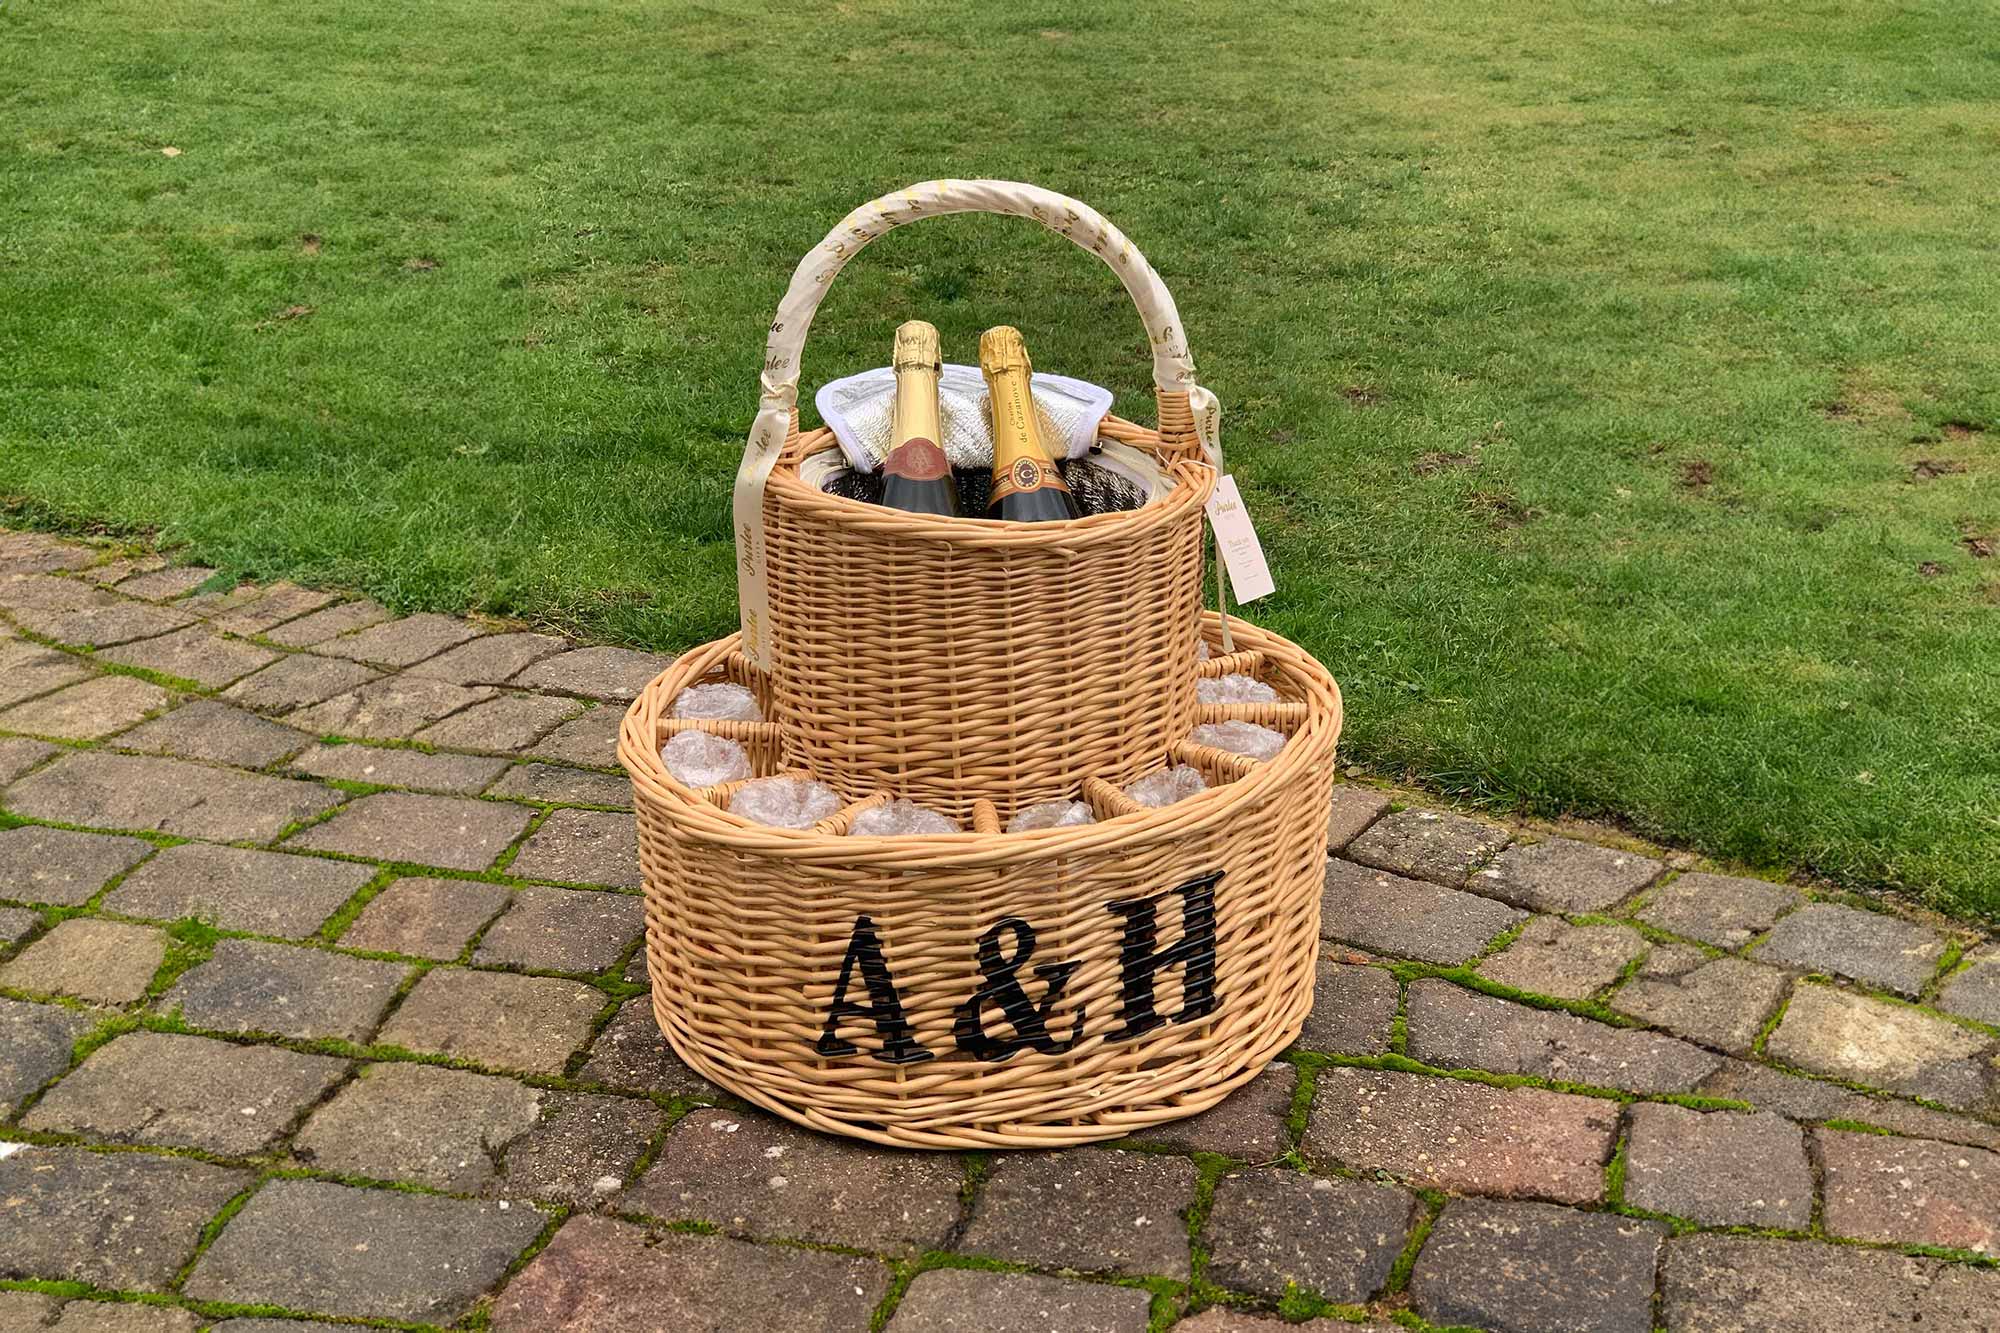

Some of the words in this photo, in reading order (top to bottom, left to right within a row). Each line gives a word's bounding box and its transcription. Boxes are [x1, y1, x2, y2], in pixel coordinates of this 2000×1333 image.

[1011, 381, 1025, 430] Cazanove
[1019, 432, 1028, 443] de
[817, 915, 934, 1063] A
[955, 917, 1086, 1061] &
[1103, 870, 1226, 1043] H
